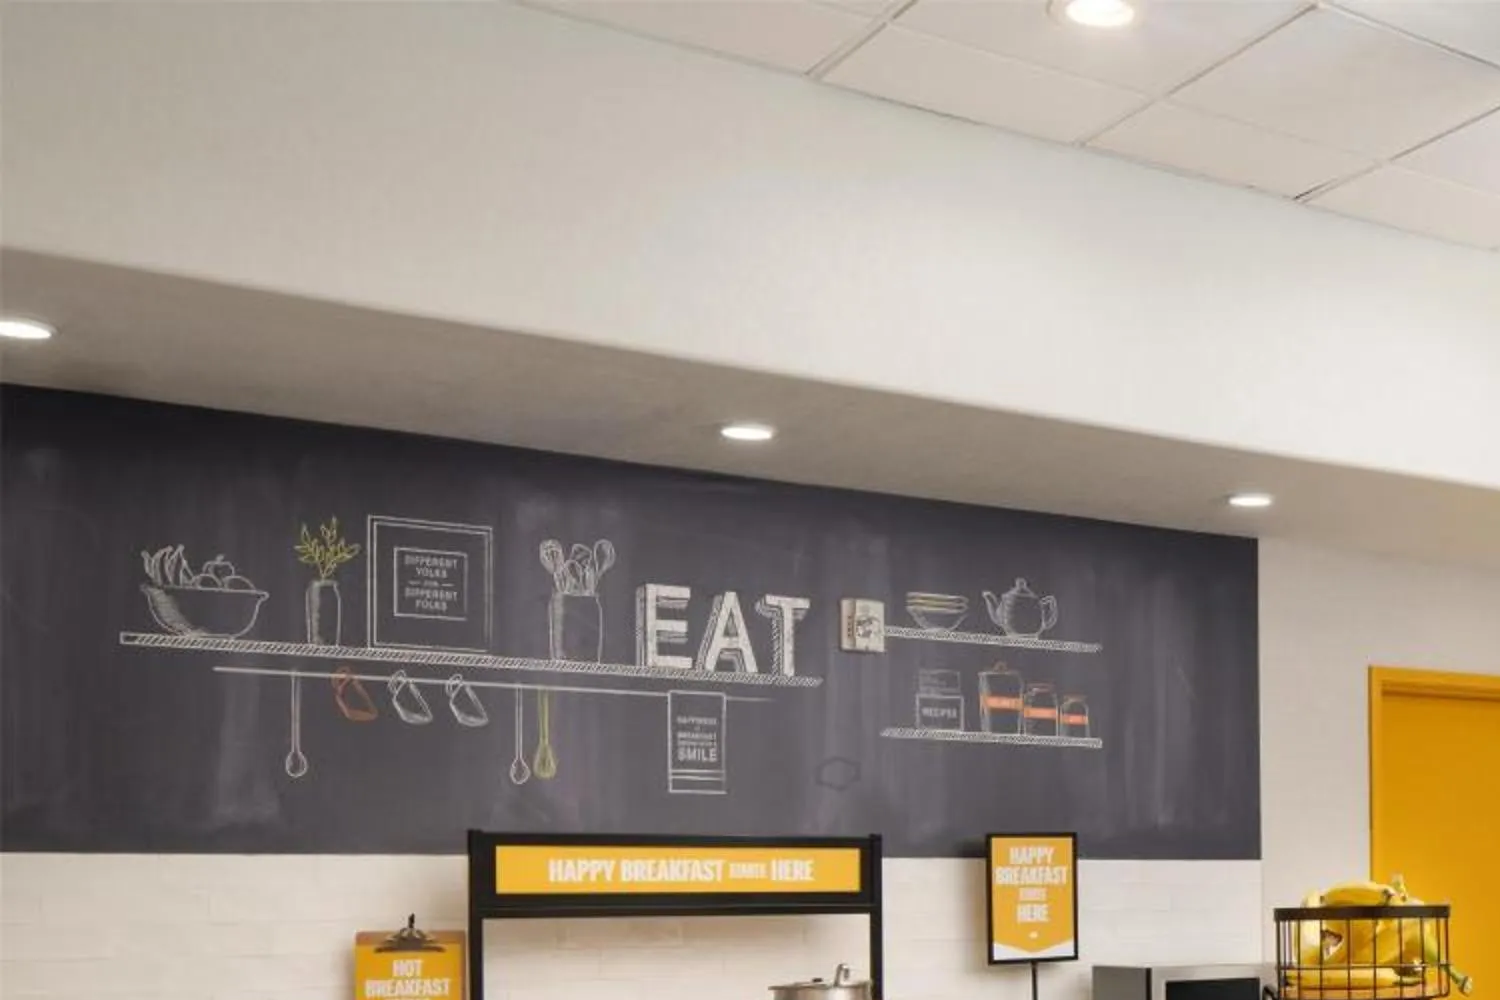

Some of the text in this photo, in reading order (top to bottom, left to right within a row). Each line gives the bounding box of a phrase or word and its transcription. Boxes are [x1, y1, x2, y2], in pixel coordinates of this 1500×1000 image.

[635, 583, 811, 678] EAT
[677, 747, 718, 762] SMILE
[1009, 846, 1055, 865] HAPPY
[548, 859, 616, 882] HAPPY
[620, 859, 724, 882] BREAKFAST
[770, 859, 815, 882] HERE
[995, 866, 1067, 886] BREAKFAST
[392, 959, 422, 977] HOT
[365, 979, 450, 999] BREAKFAST
